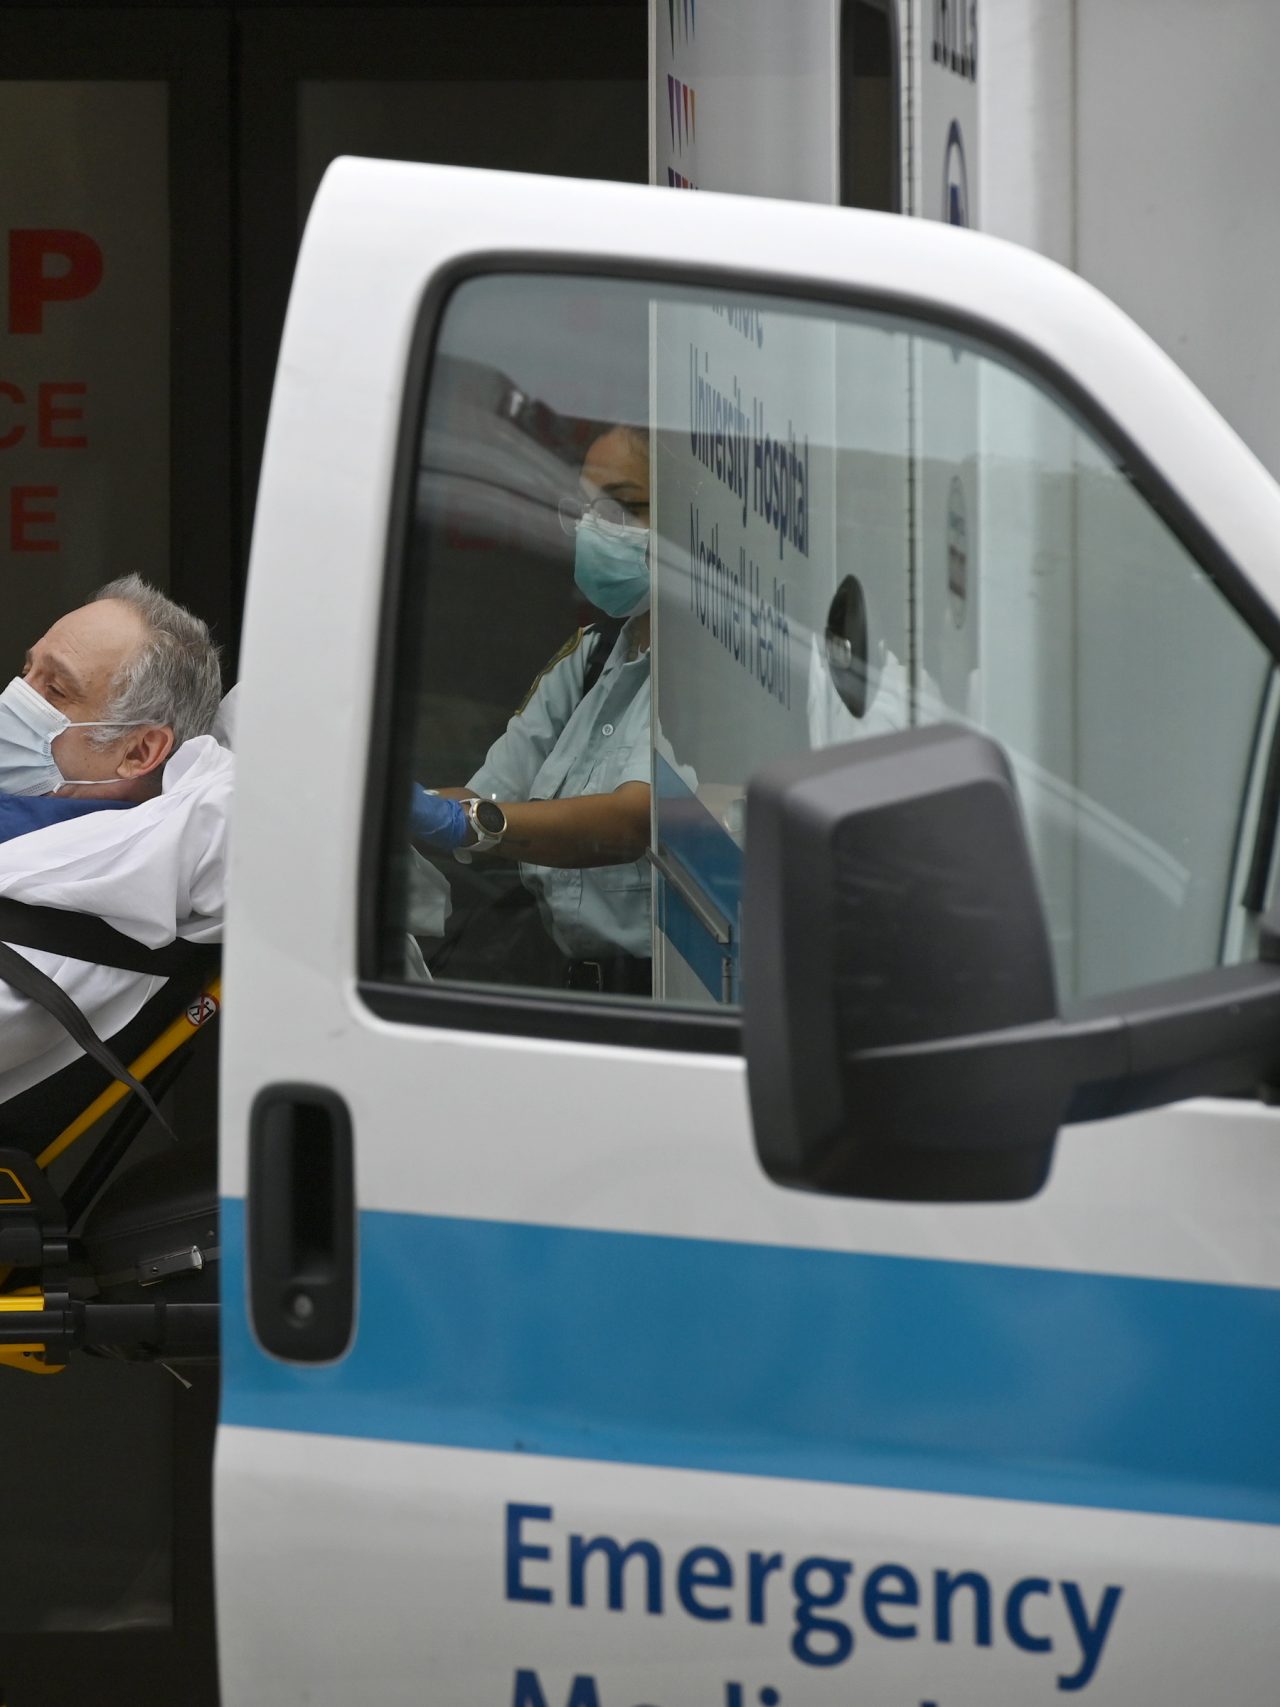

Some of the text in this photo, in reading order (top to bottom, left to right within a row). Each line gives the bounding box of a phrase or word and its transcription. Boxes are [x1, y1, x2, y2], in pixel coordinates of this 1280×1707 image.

[690, 342, 750, 528] University
[754, 397, 809, 560] Hospital
[690, 503, 791, 711] Northwell Health
[504, 1501, 1124, 1692] Emergency
